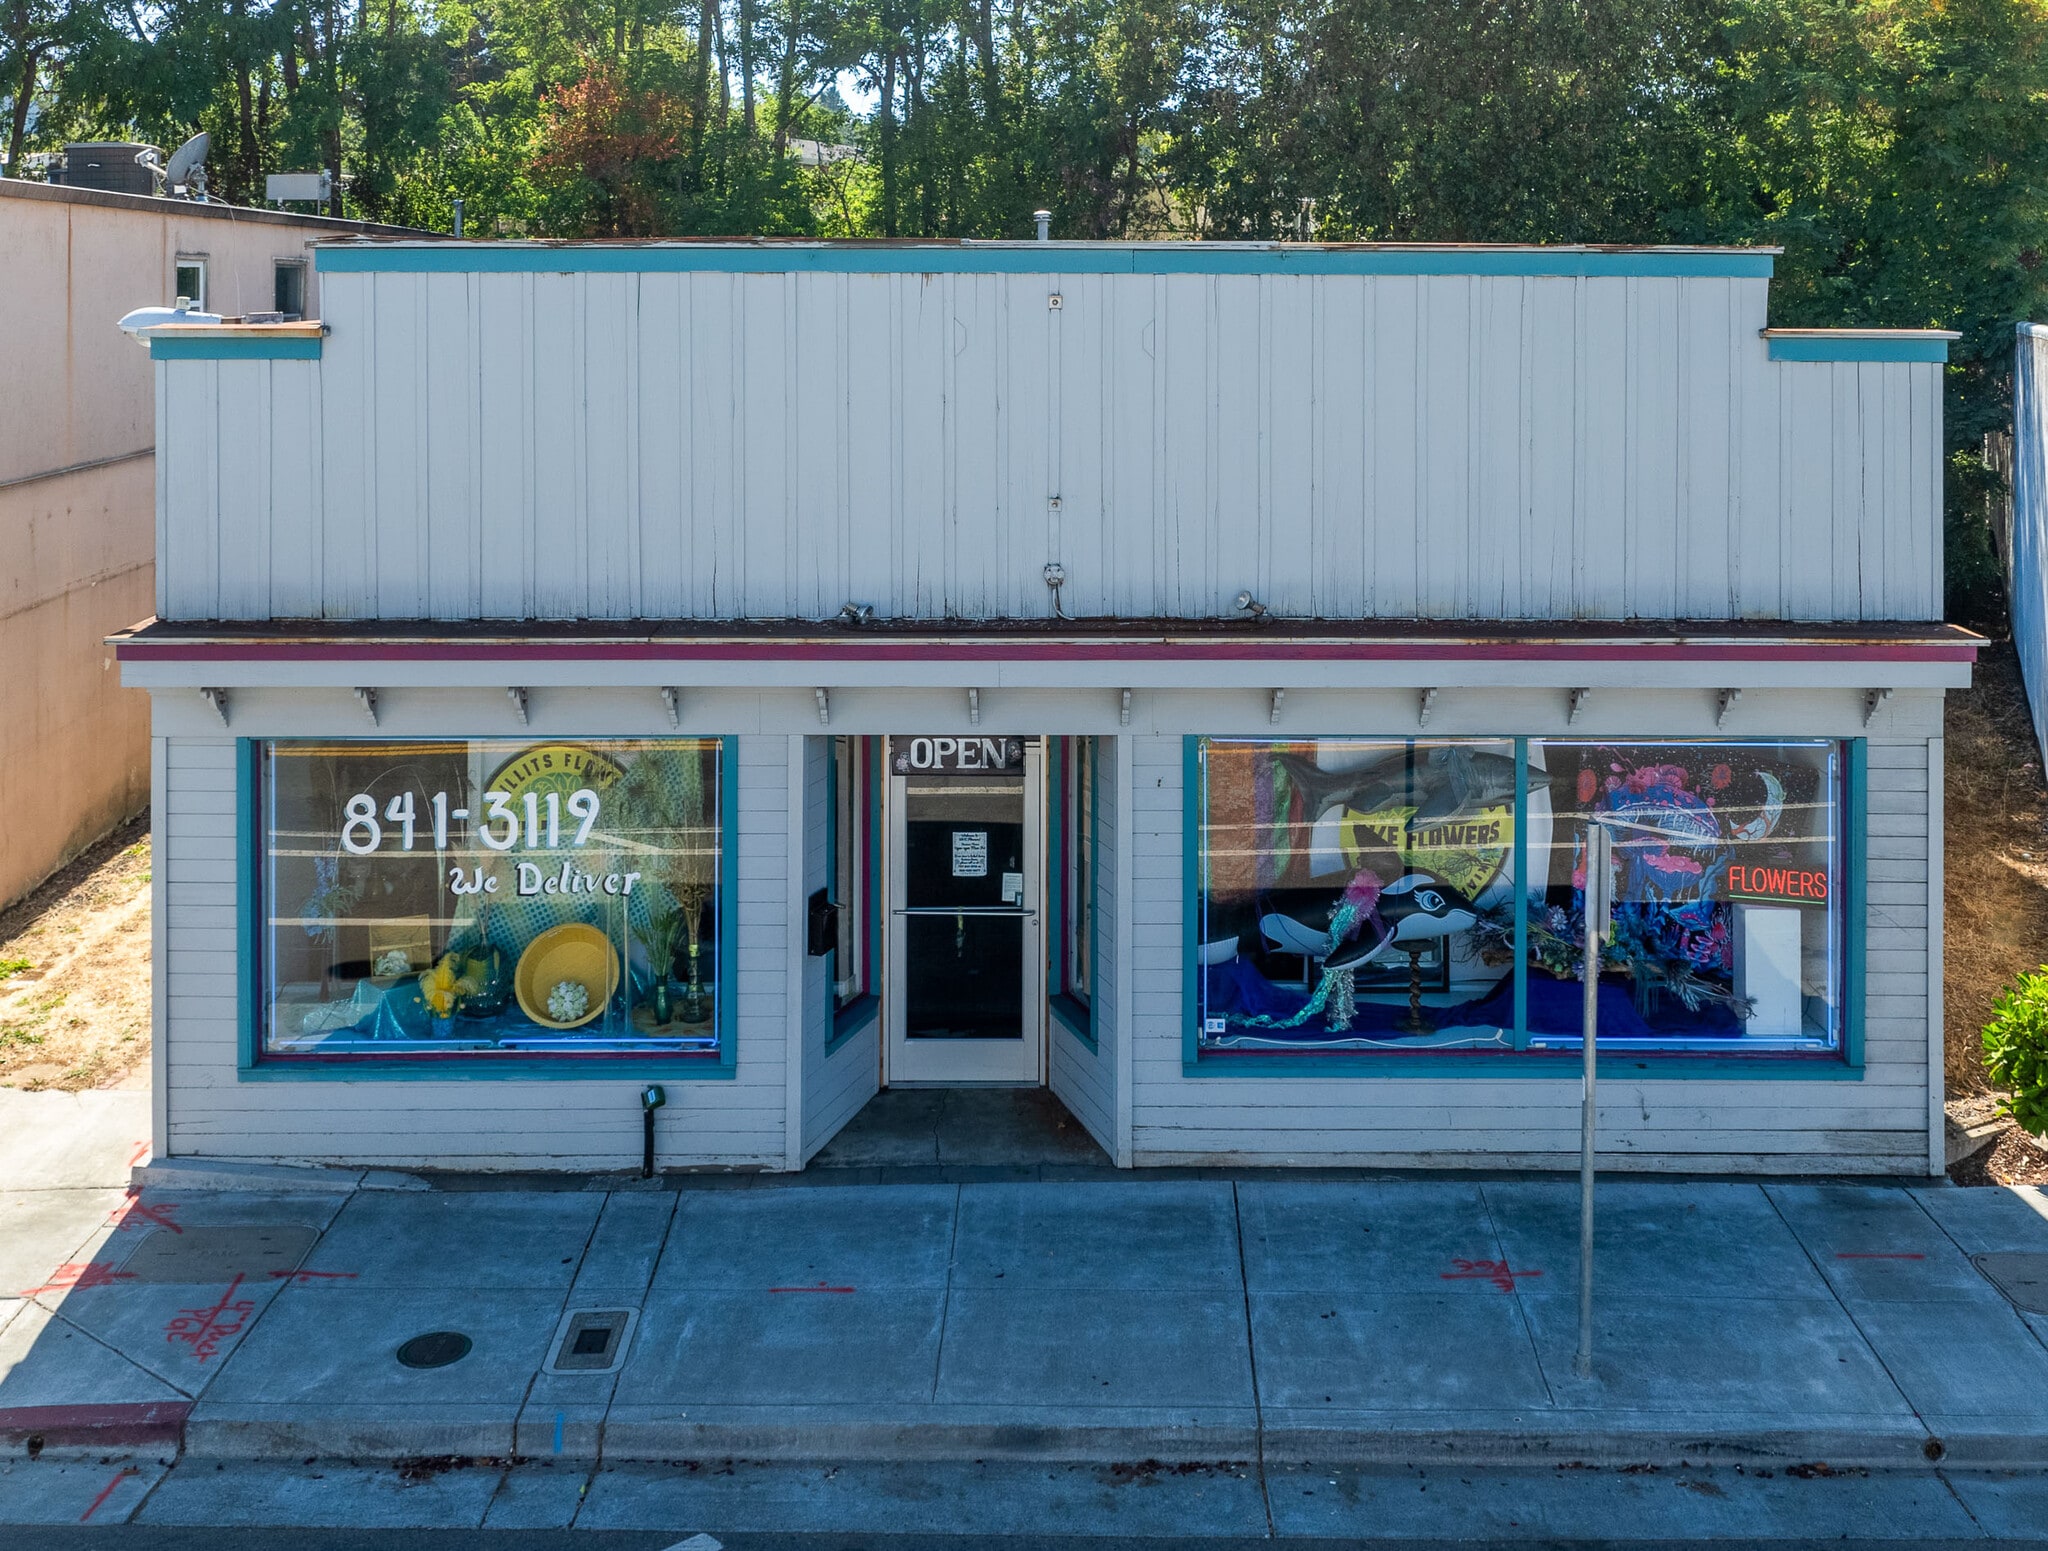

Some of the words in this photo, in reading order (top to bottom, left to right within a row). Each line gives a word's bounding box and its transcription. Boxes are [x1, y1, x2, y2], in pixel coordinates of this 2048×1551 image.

[909, 738, 1008, 770] OPEN
[498, 754, 553, 794] ILLITS
[341, 789, 600, 855] 841-3119
[1409, 820, 1500, 848] FLOWERS
[449, 866, 500, 896] We
[515, 861, 642, 897] Deliver
[1729, 866, 1828, 898] FLOWERS
